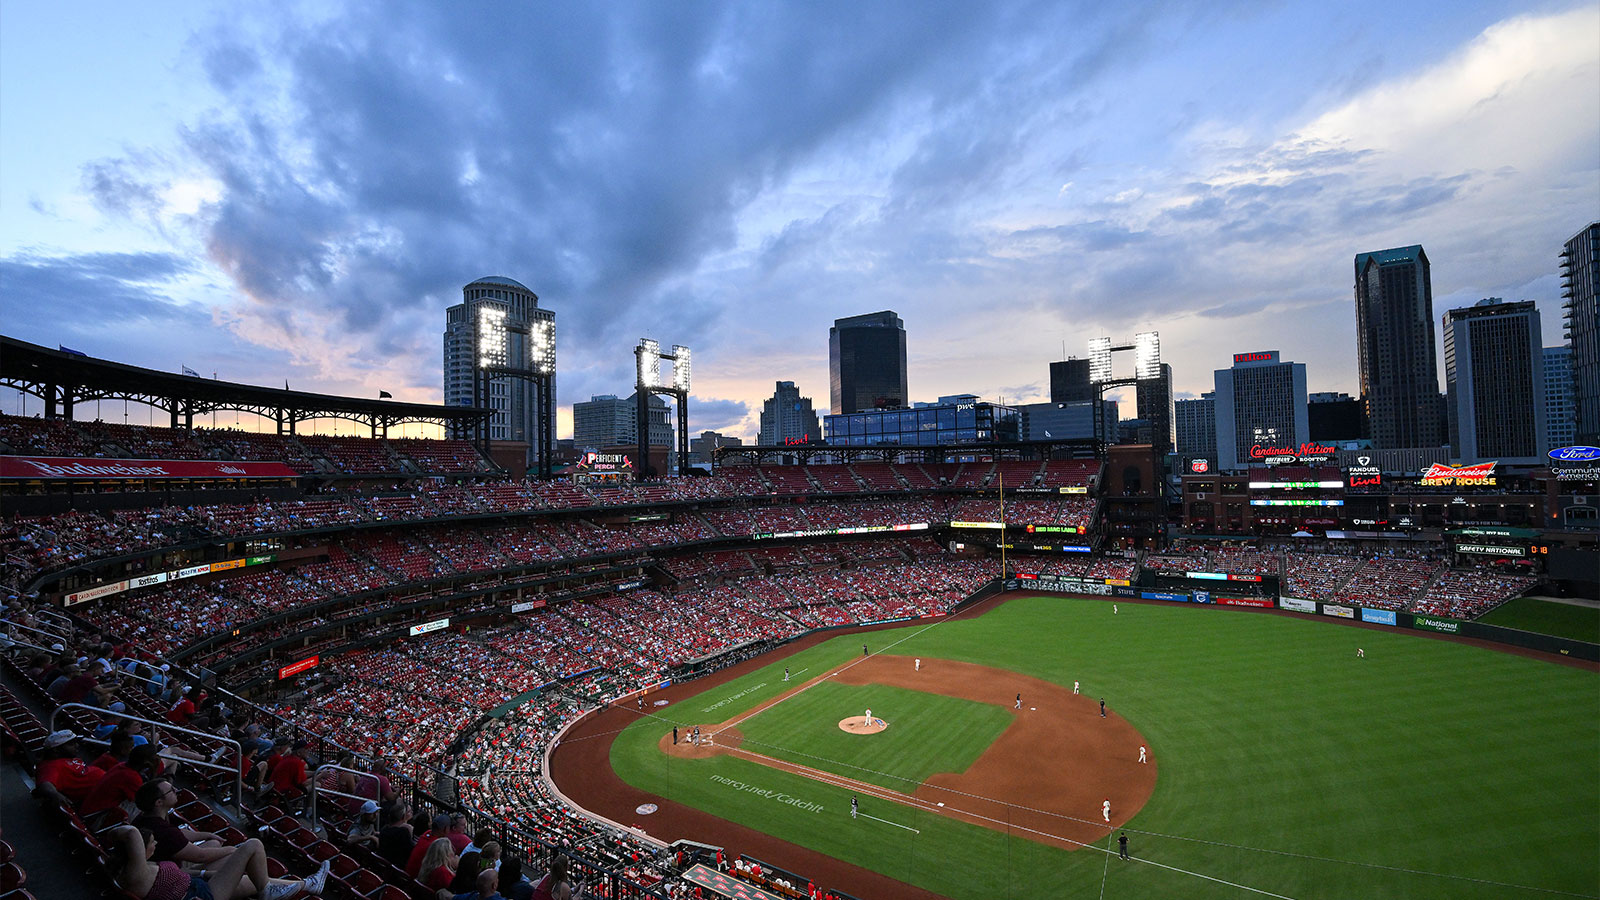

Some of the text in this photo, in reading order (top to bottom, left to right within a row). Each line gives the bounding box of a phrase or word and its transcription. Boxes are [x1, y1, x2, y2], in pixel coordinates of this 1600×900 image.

[1235, 353, 1272, 362] Hilton
[957, 403, 975, 412] pwc
[1250, 442, 1335, 458] Cardinals Nation
[1560, 448, 1595, 458] Ford
[587, 452, 622, 464] PERFICIENT
[23, 460, 170, 476] Budweiser
[1420, 467, 1495, 477] Budweiser
[1350, 475, 1381, 487] Live!
[1421, 478, 1497, 486] BREW HOUSE
[1485, 547, 1521, 555] NATIONAL
[1425, 619, 1458, 629] National
[709, 774, 825, 814] mercy.net/CatchIt
